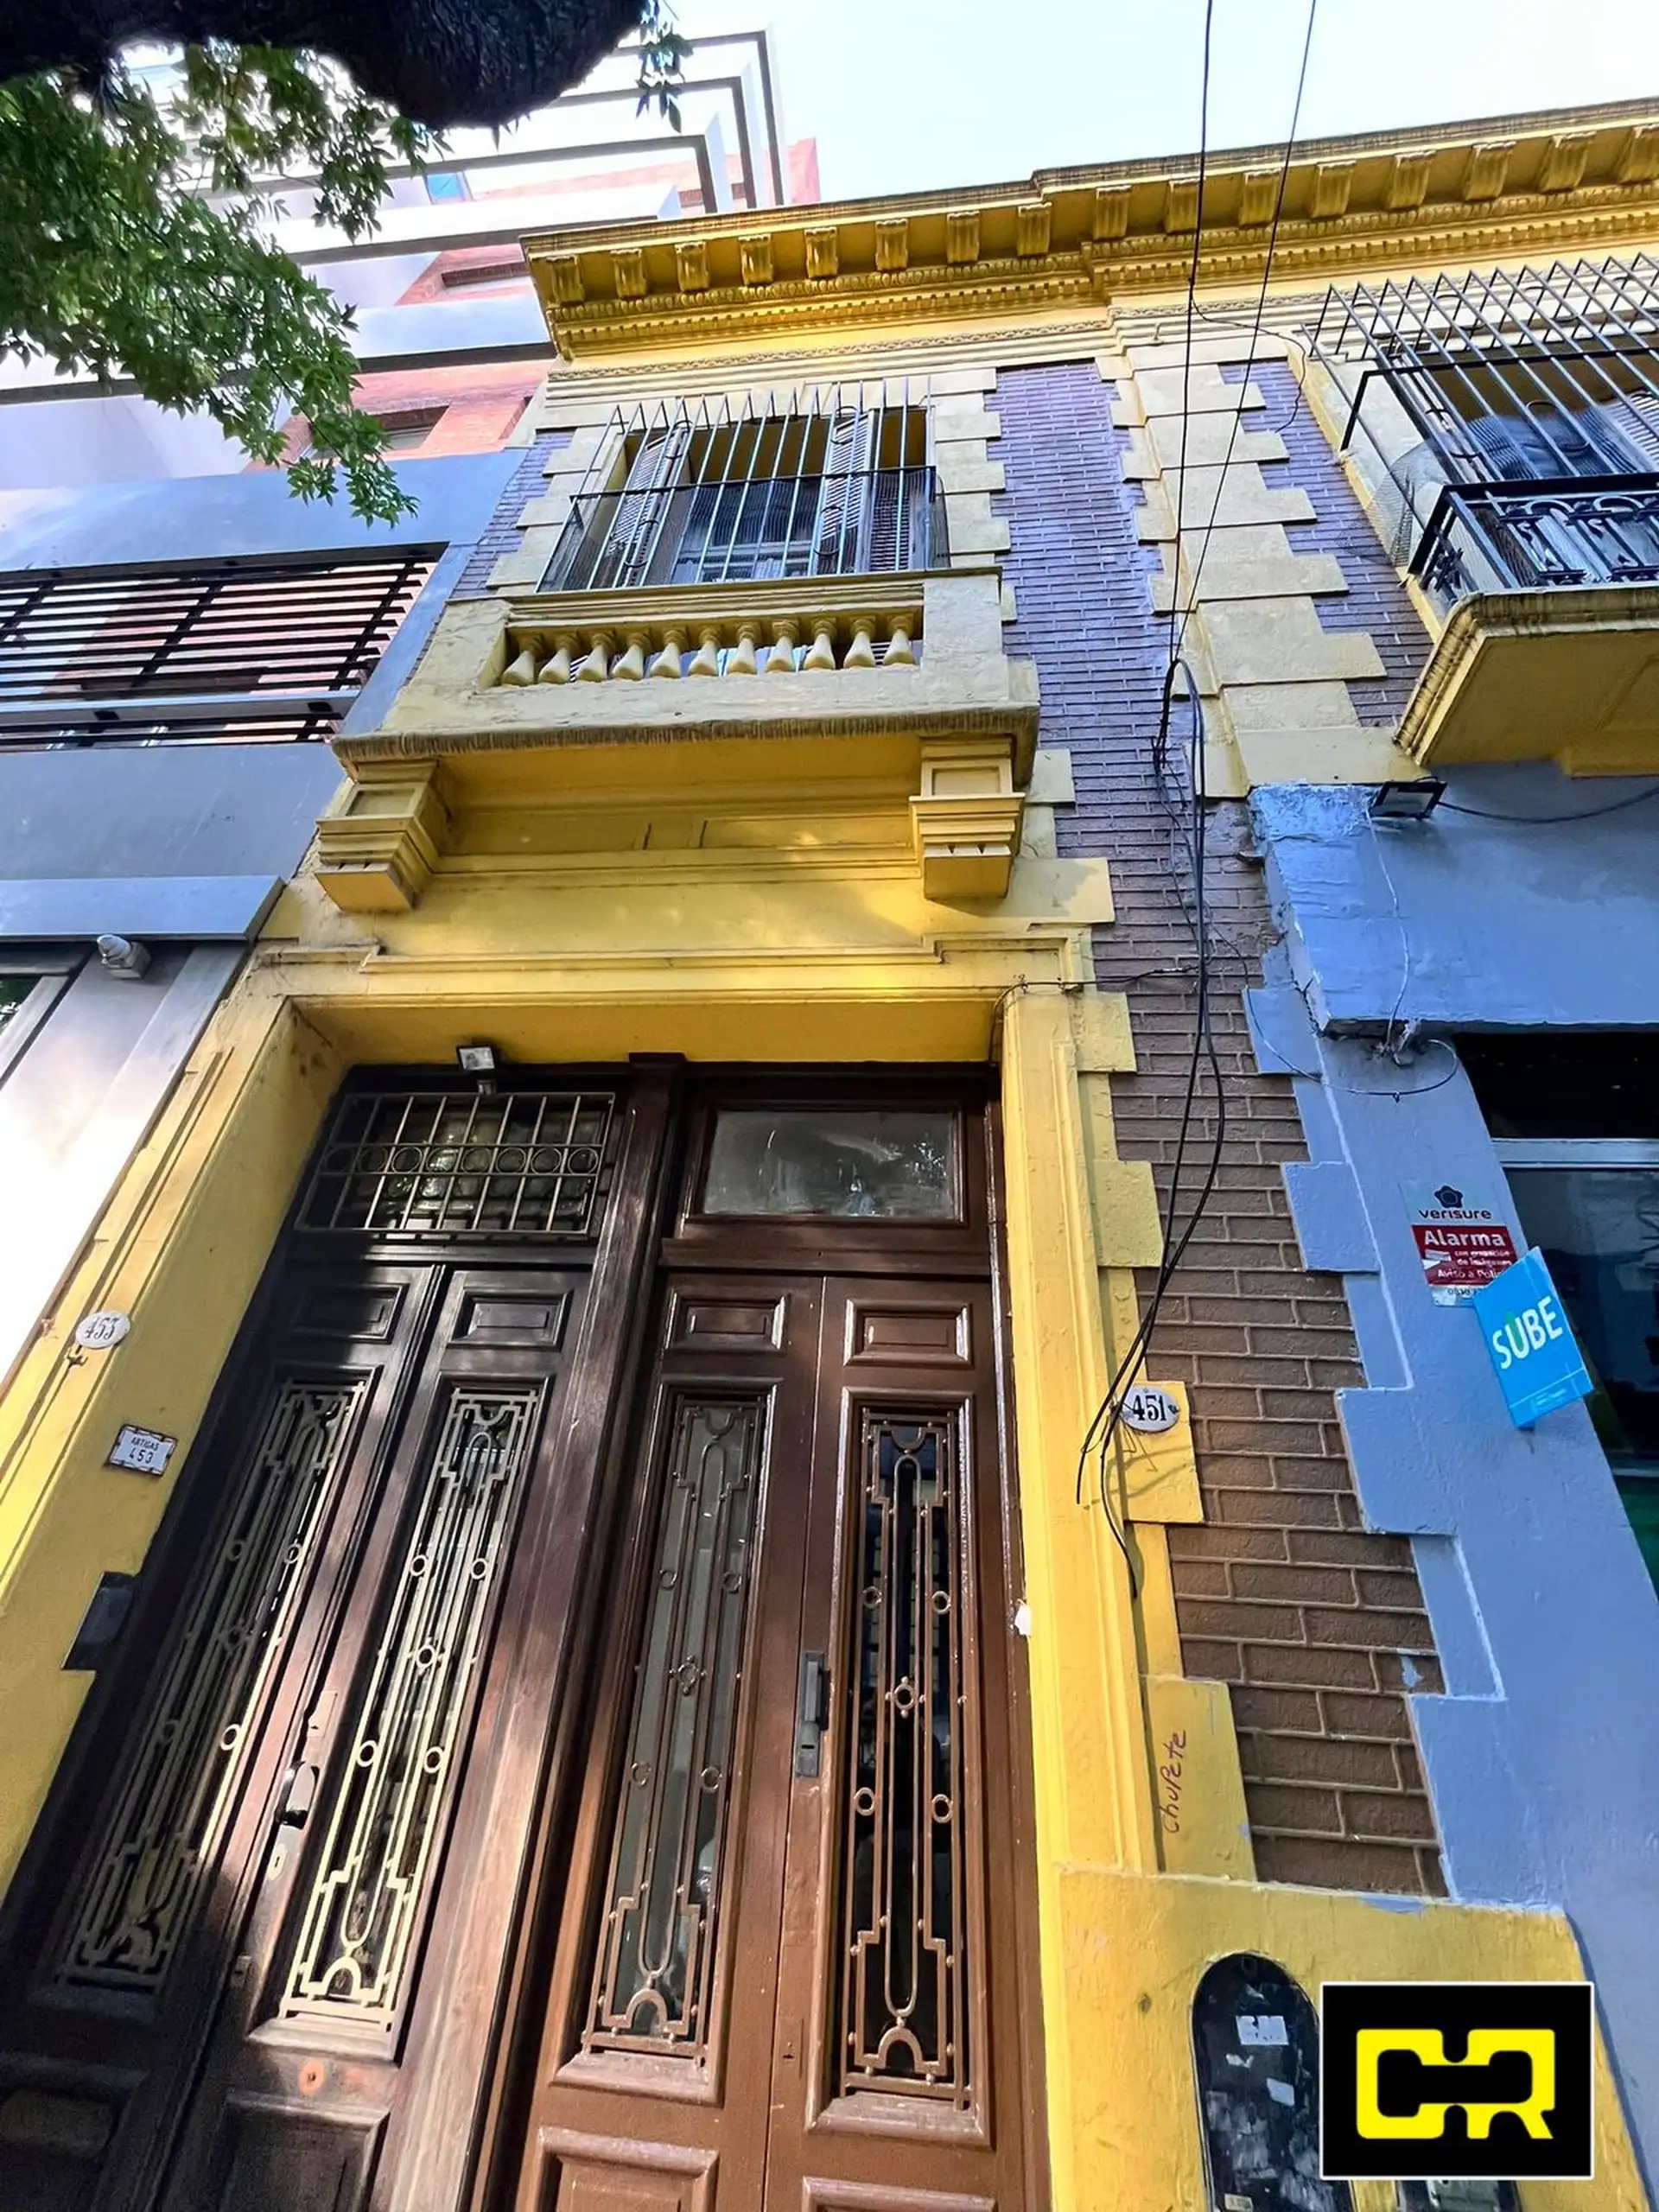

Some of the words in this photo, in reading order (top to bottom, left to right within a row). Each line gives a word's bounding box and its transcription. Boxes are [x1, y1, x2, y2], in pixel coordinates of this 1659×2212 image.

[1419, 1209, 1492, 1220] verisure
[1424, 1229, 1506, 1247] Alarma
[1438, 1268, 1466, 1278] Aviso
[85, 1317, 120, 1340] 453
[1491, 1295, 1563, 1370] SUBE
[1133, 1395, 1166, 1421] 451
[130, 1436, 160, 1452] ARTIGAS
[129, 1448, 155, 1465] 453
